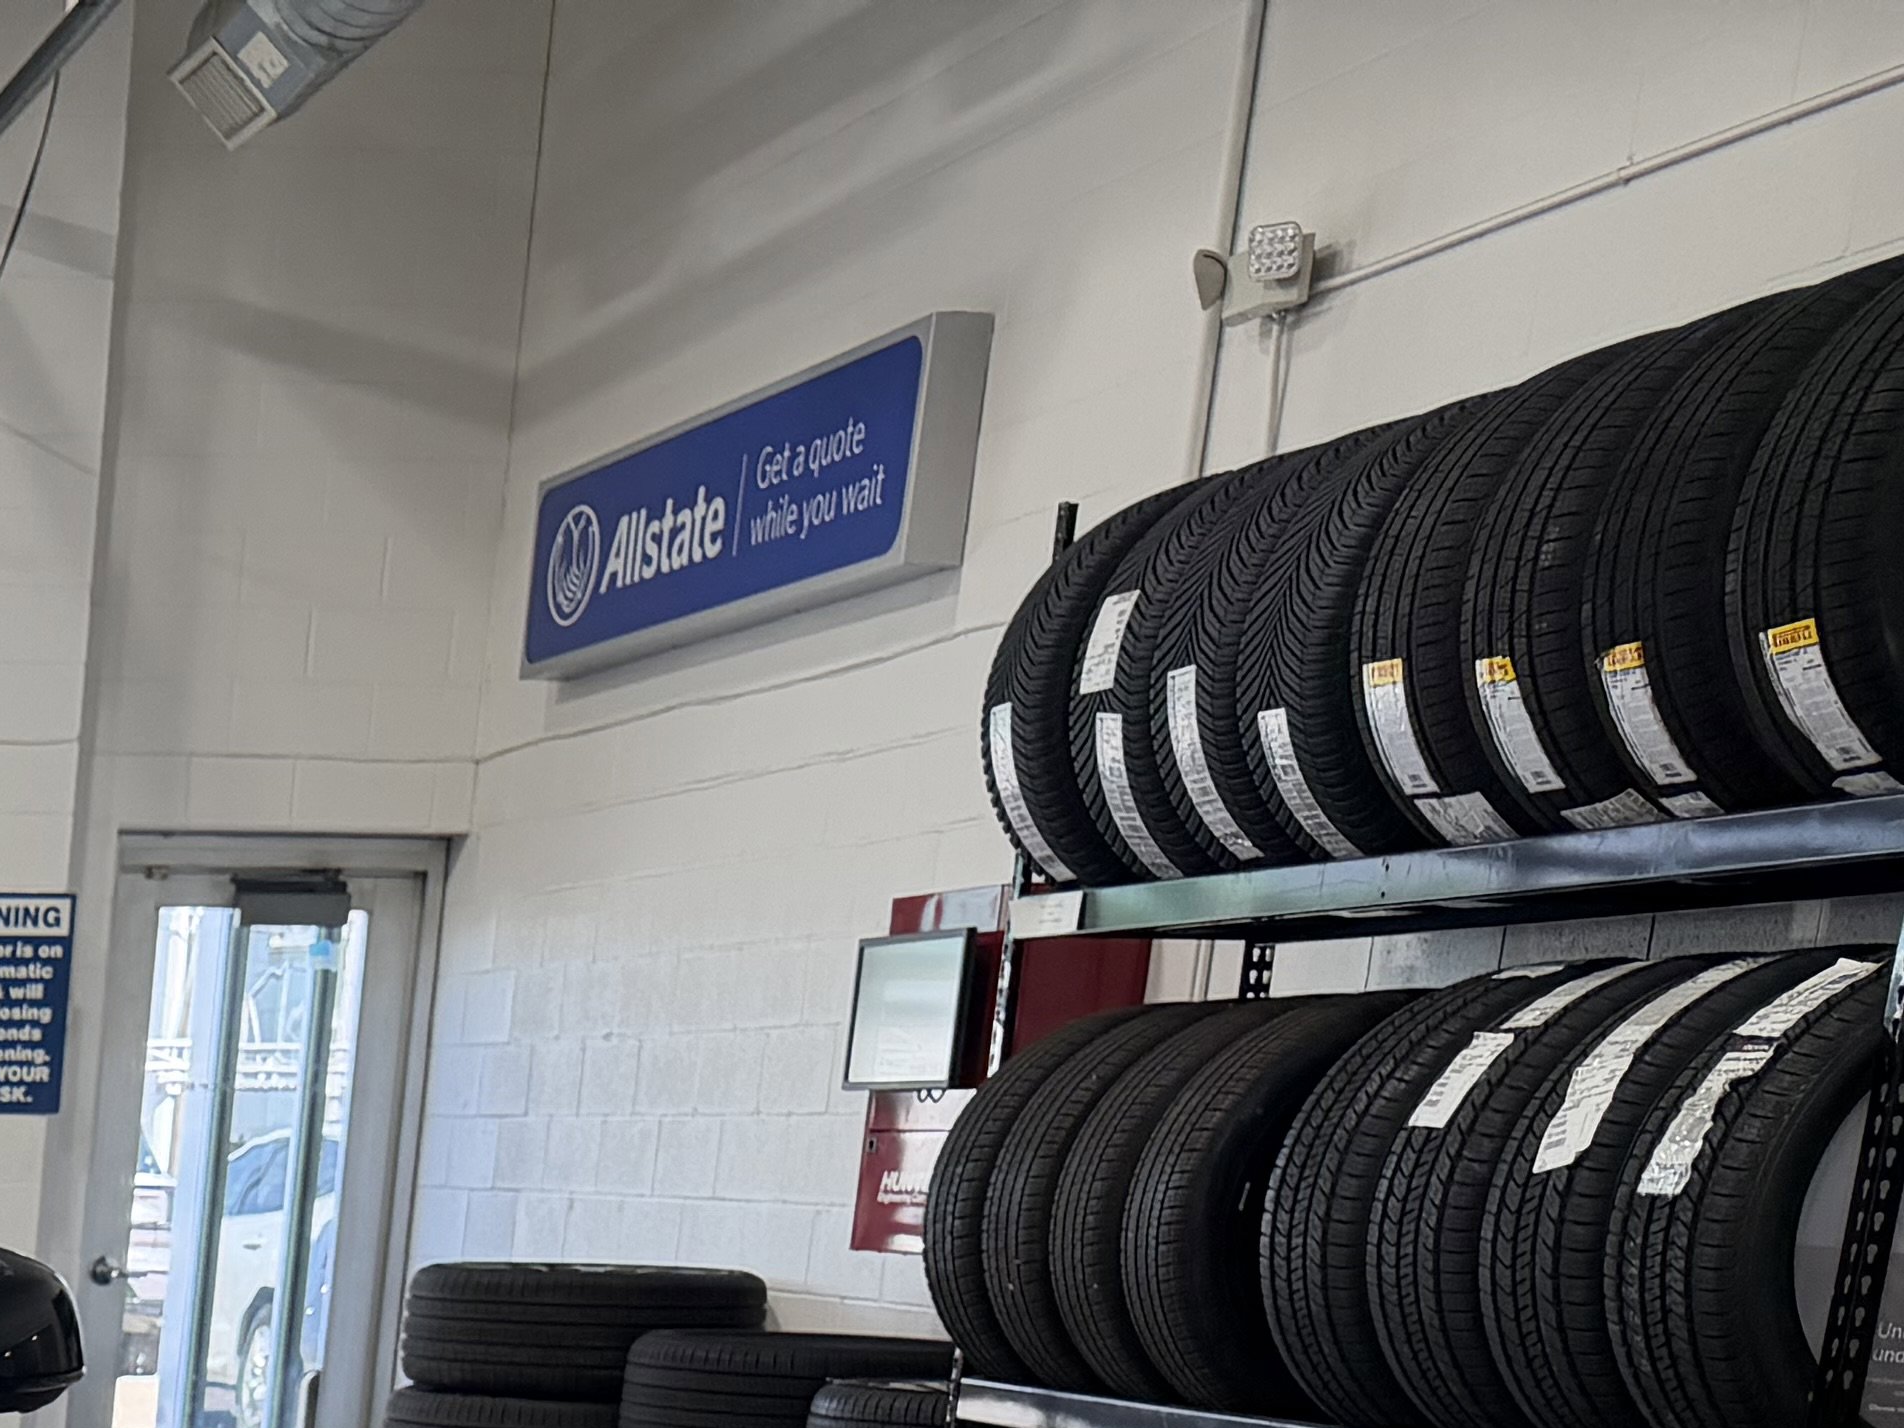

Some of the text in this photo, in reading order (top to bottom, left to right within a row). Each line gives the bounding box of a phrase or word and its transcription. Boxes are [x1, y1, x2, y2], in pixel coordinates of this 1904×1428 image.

[757, 417, 866, 489] Get a quote
[599, 486, 726, 595] Allstate
[750, 464, 886, 546] while you wait
[16, 941, 34, 958] is
[38, 945, 64, 959] on
[9, 983, 45, 1000] will
